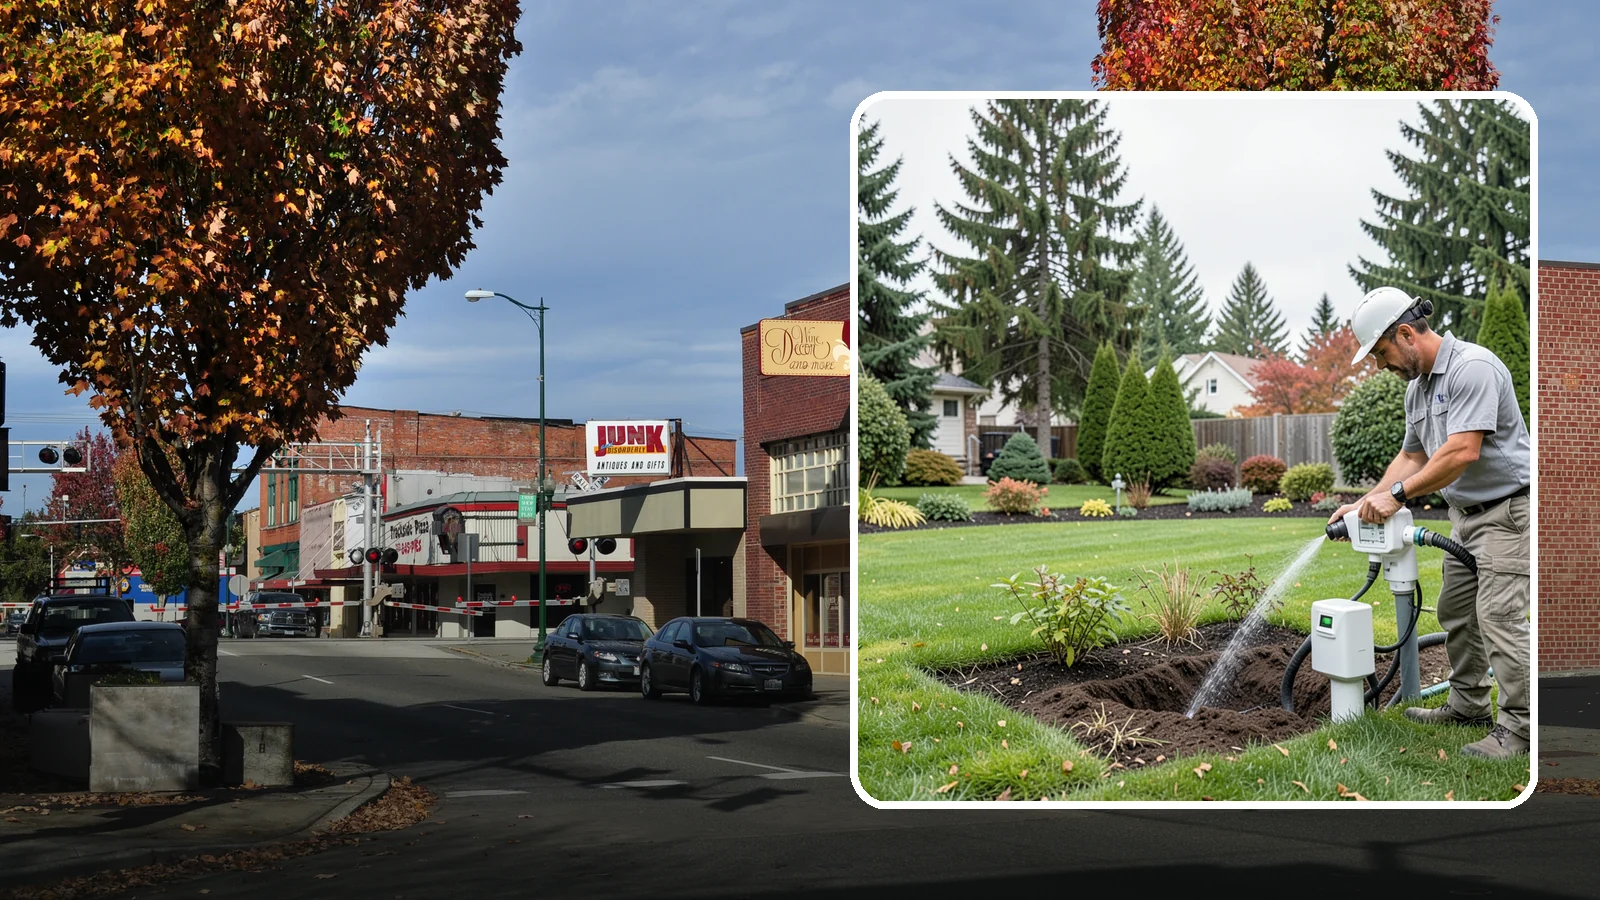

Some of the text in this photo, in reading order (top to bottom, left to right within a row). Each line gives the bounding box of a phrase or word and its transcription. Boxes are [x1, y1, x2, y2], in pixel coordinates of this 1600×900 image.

[764, 327, 831, 365] Decor
[596, 425, 665, 457] JUNK
[607, 446, 646, 454] DISORDERLY
[597, 460, 665, 470] ANTIQUES AND GIFTS
